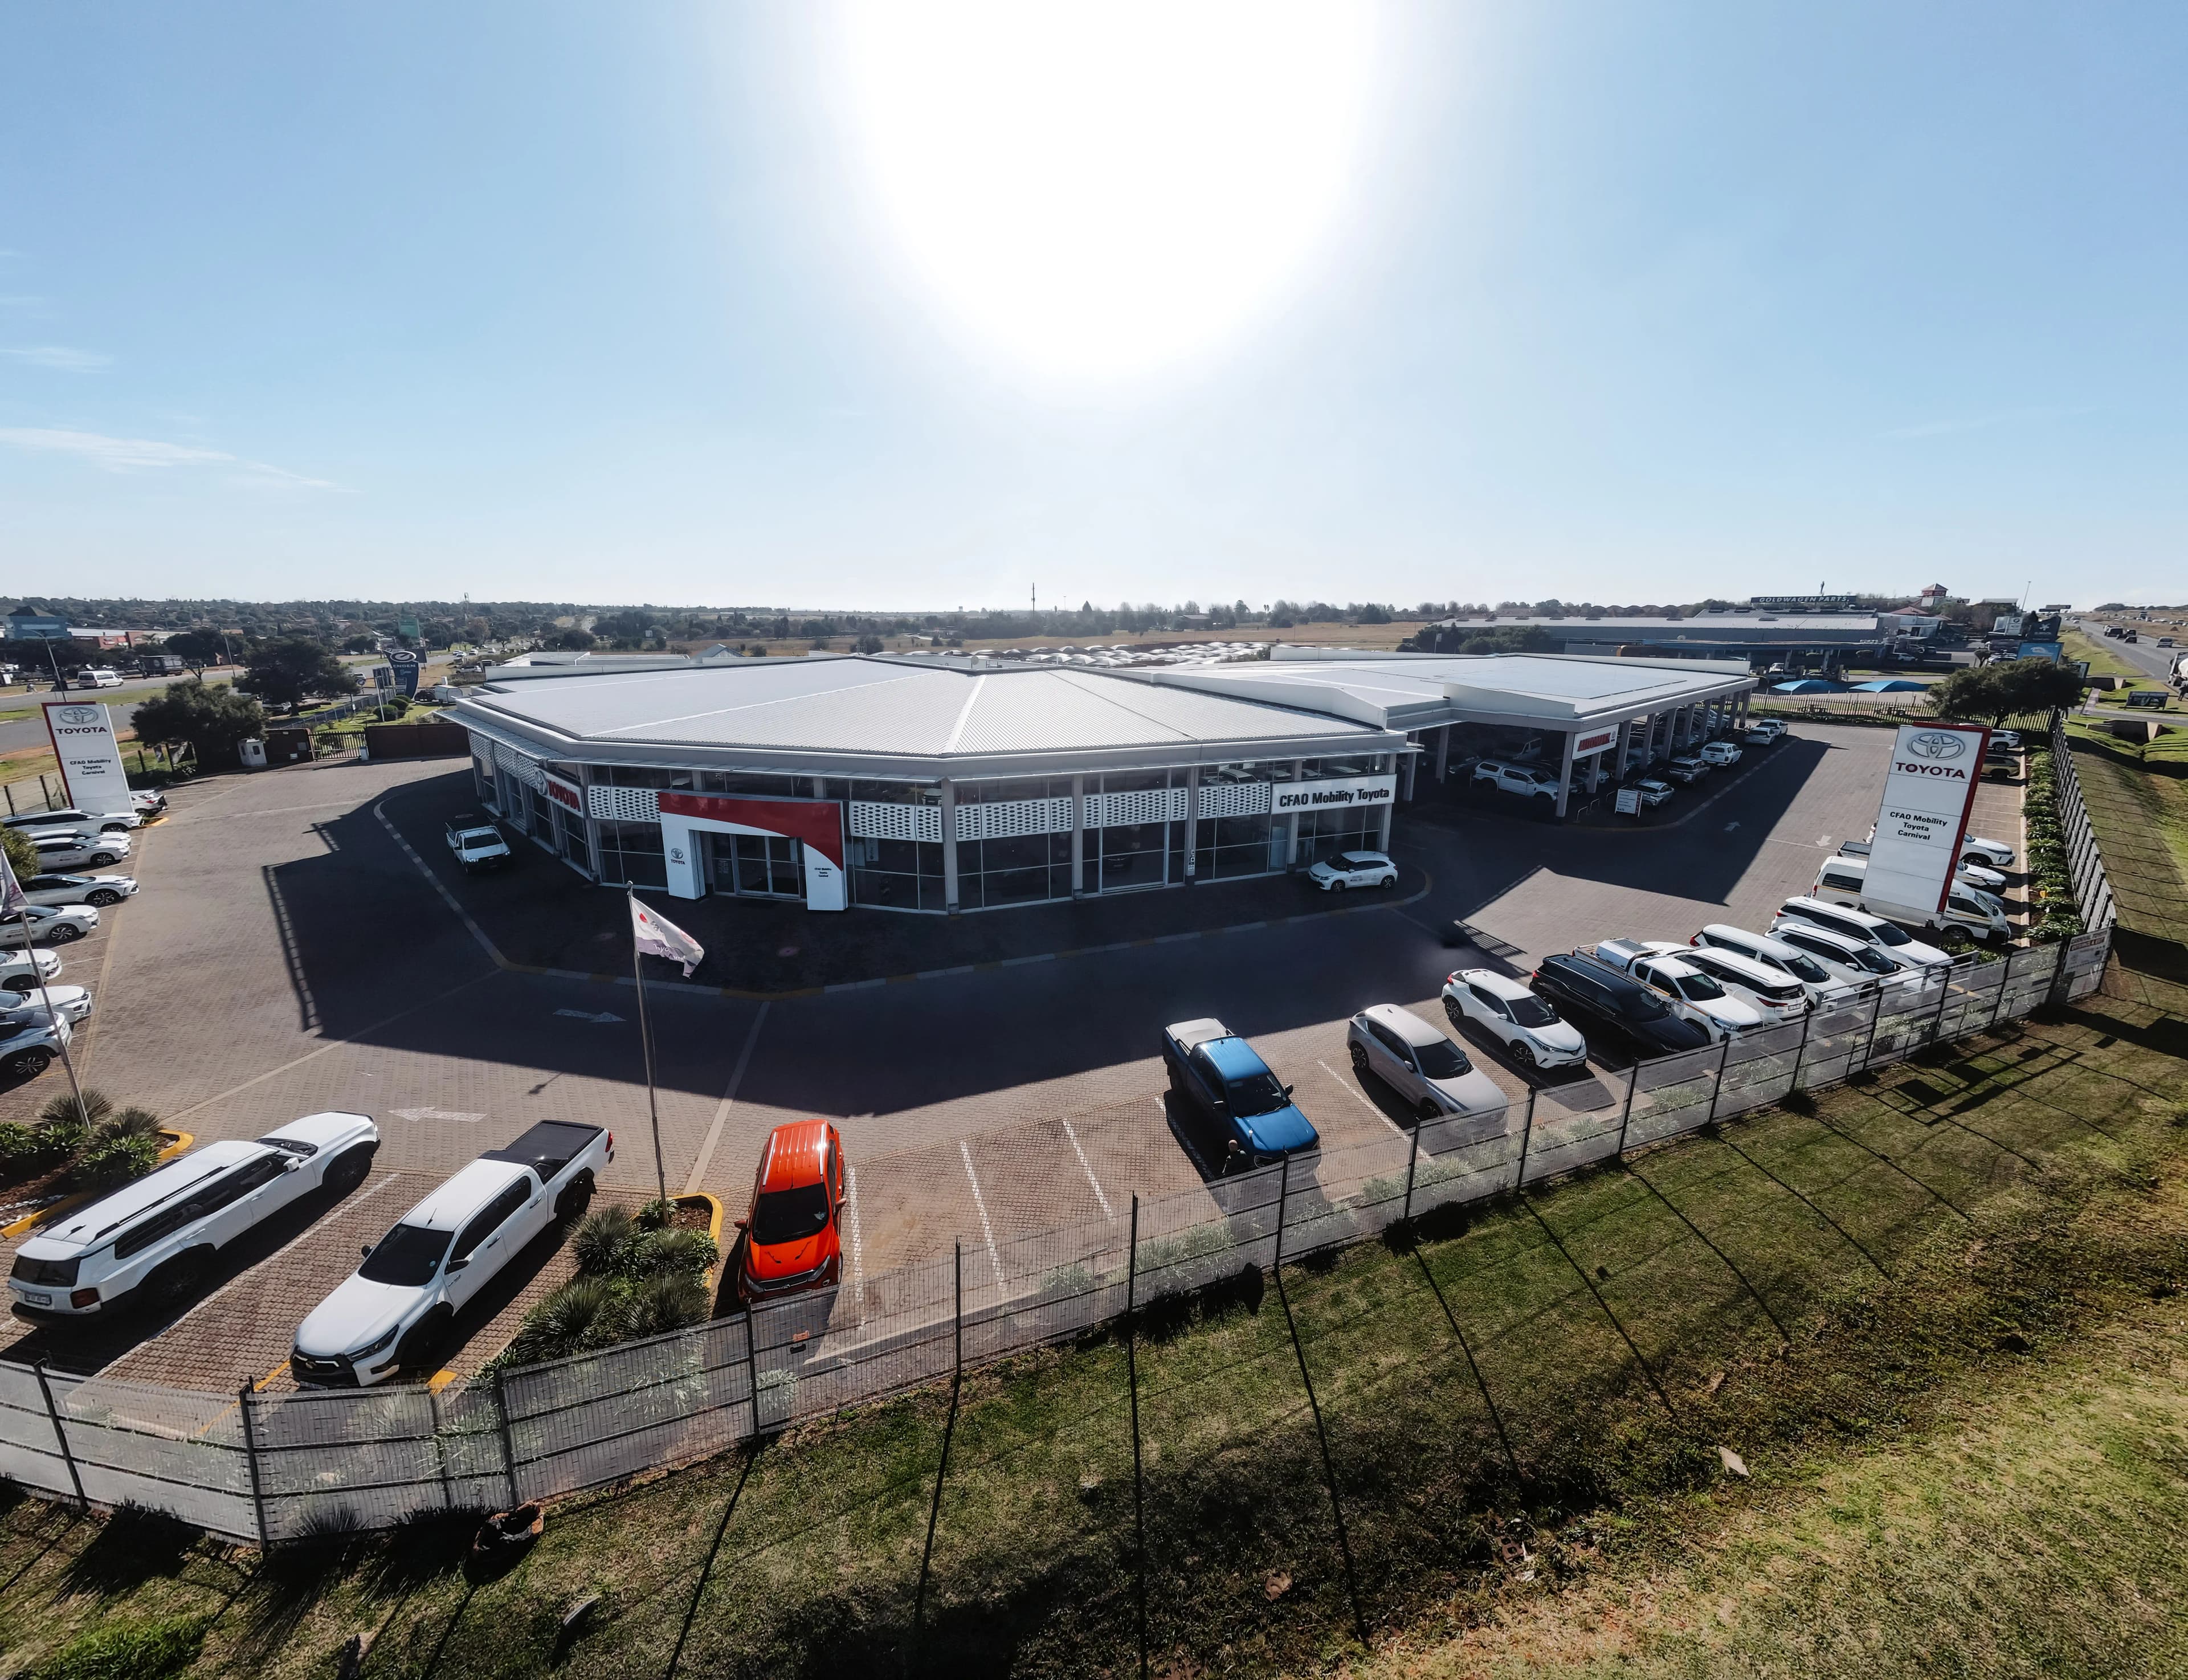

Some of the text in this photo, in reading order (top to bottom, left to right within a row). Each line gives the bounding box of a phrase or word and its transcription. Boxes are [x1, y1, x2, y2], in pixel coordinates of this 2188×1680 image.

[1896, 762, 1965, 779] TOYOTA
[547, 779, 581, 812] TOYOTA
[1280, 788, 1390, 807] CFAO Mobility Toyota
[1890, 811, 1948, 827] CFAO Mobility
[1903, 822, 1929, 832] Toyota
[1898, 830, 1930, 840] Carnival
